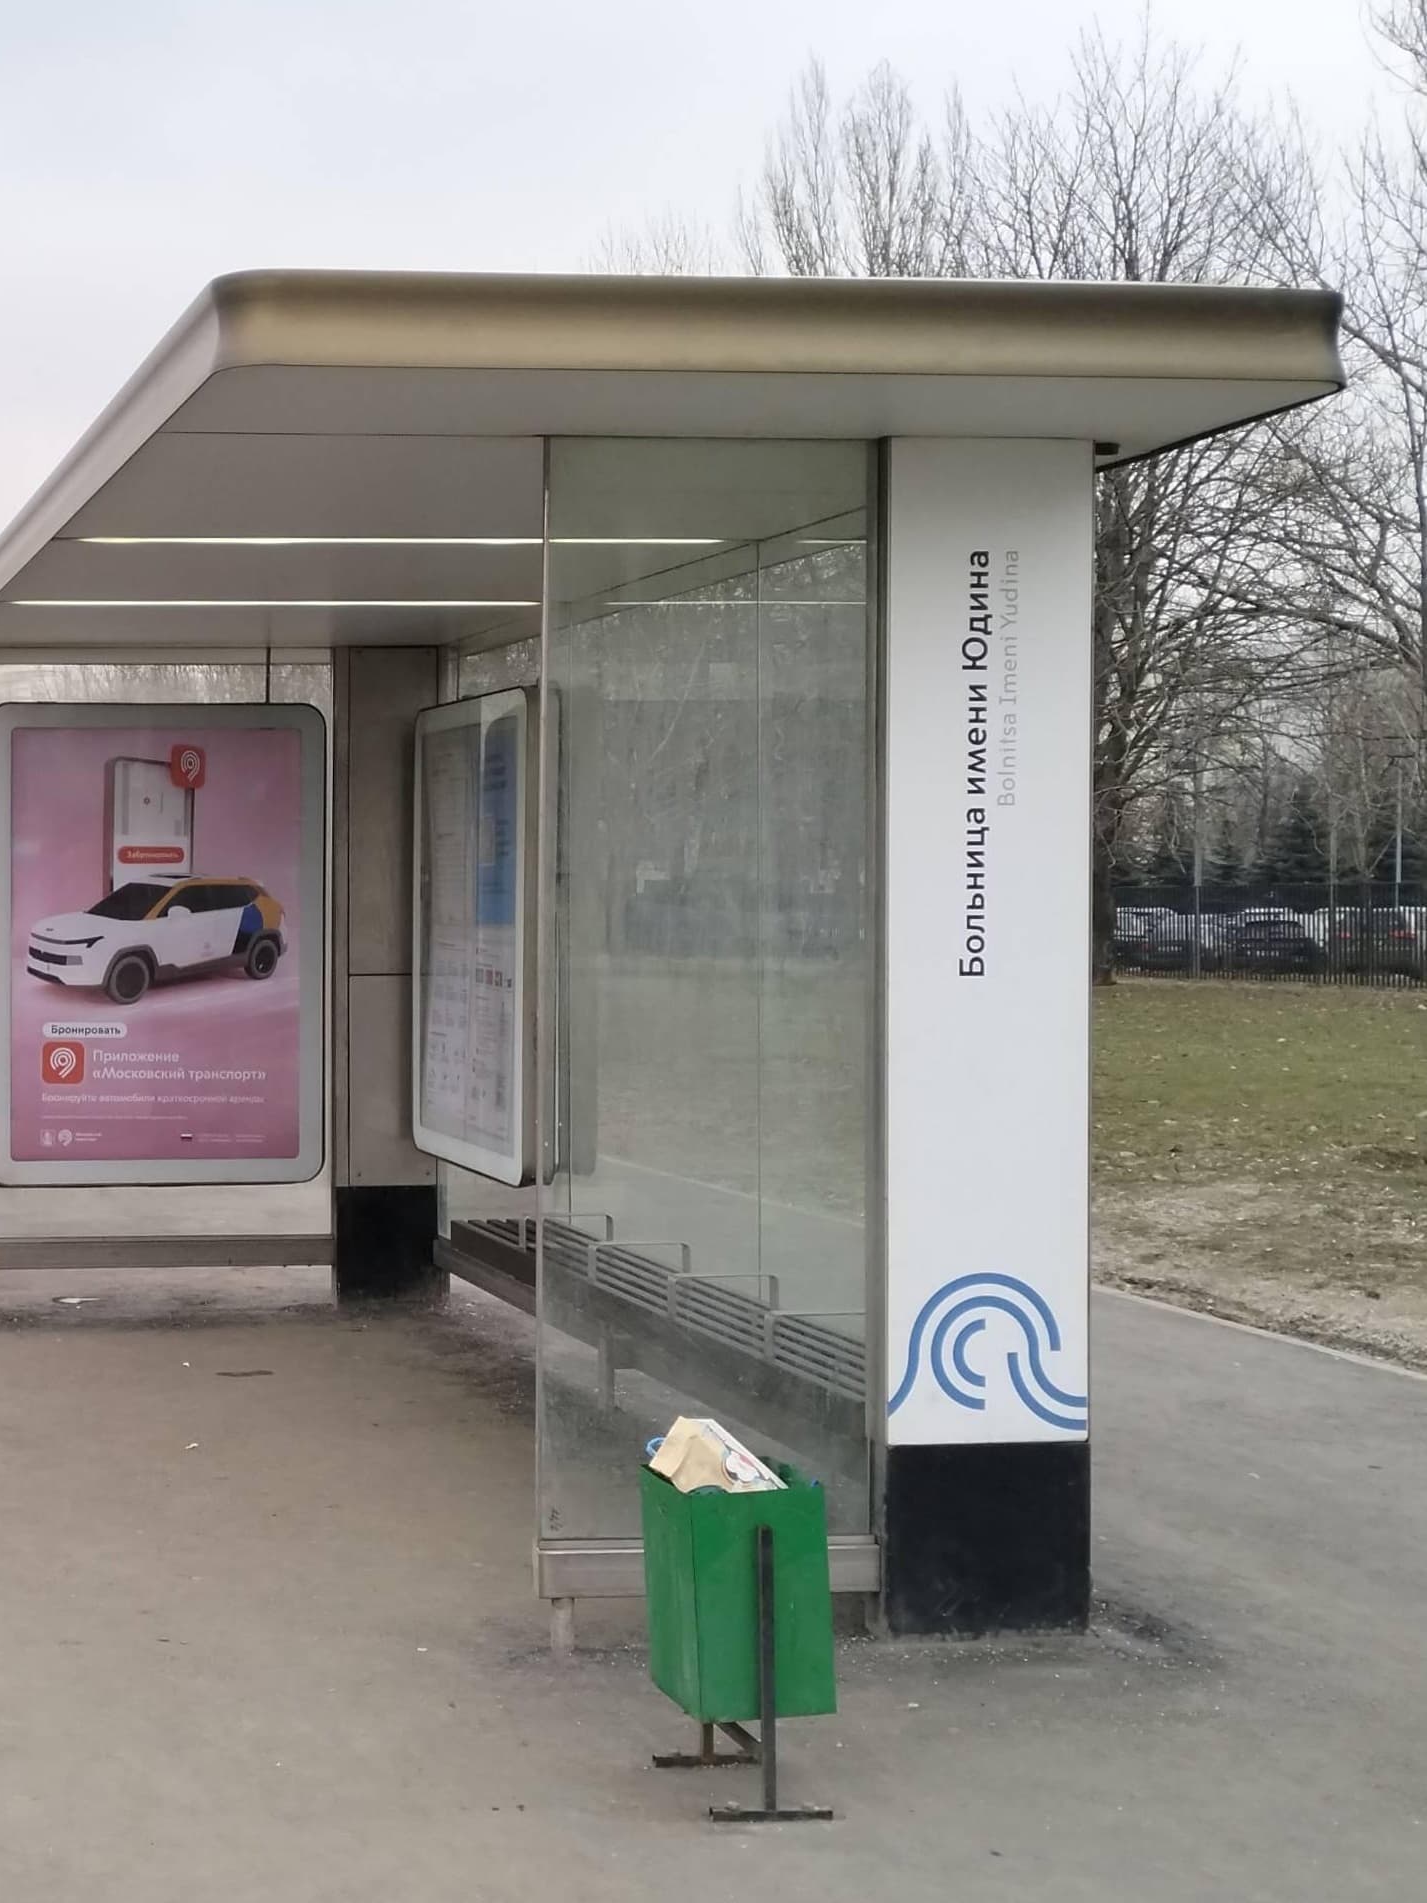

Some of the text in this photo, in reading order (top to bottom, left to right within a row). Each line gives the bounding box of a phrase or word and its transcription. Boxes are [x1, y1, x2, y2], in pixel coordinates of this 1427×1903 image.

[996, 550, 1019, 806] Bolnitsa Imeni Yudina
[959, 550, 993, 977] Больница имени Юдина
[51, 1025, 121, 1036] Бронировать
[93, 1050, 180, 1064] Приложение
[93, 1067, 267, 1082] «Московский транспорт»
